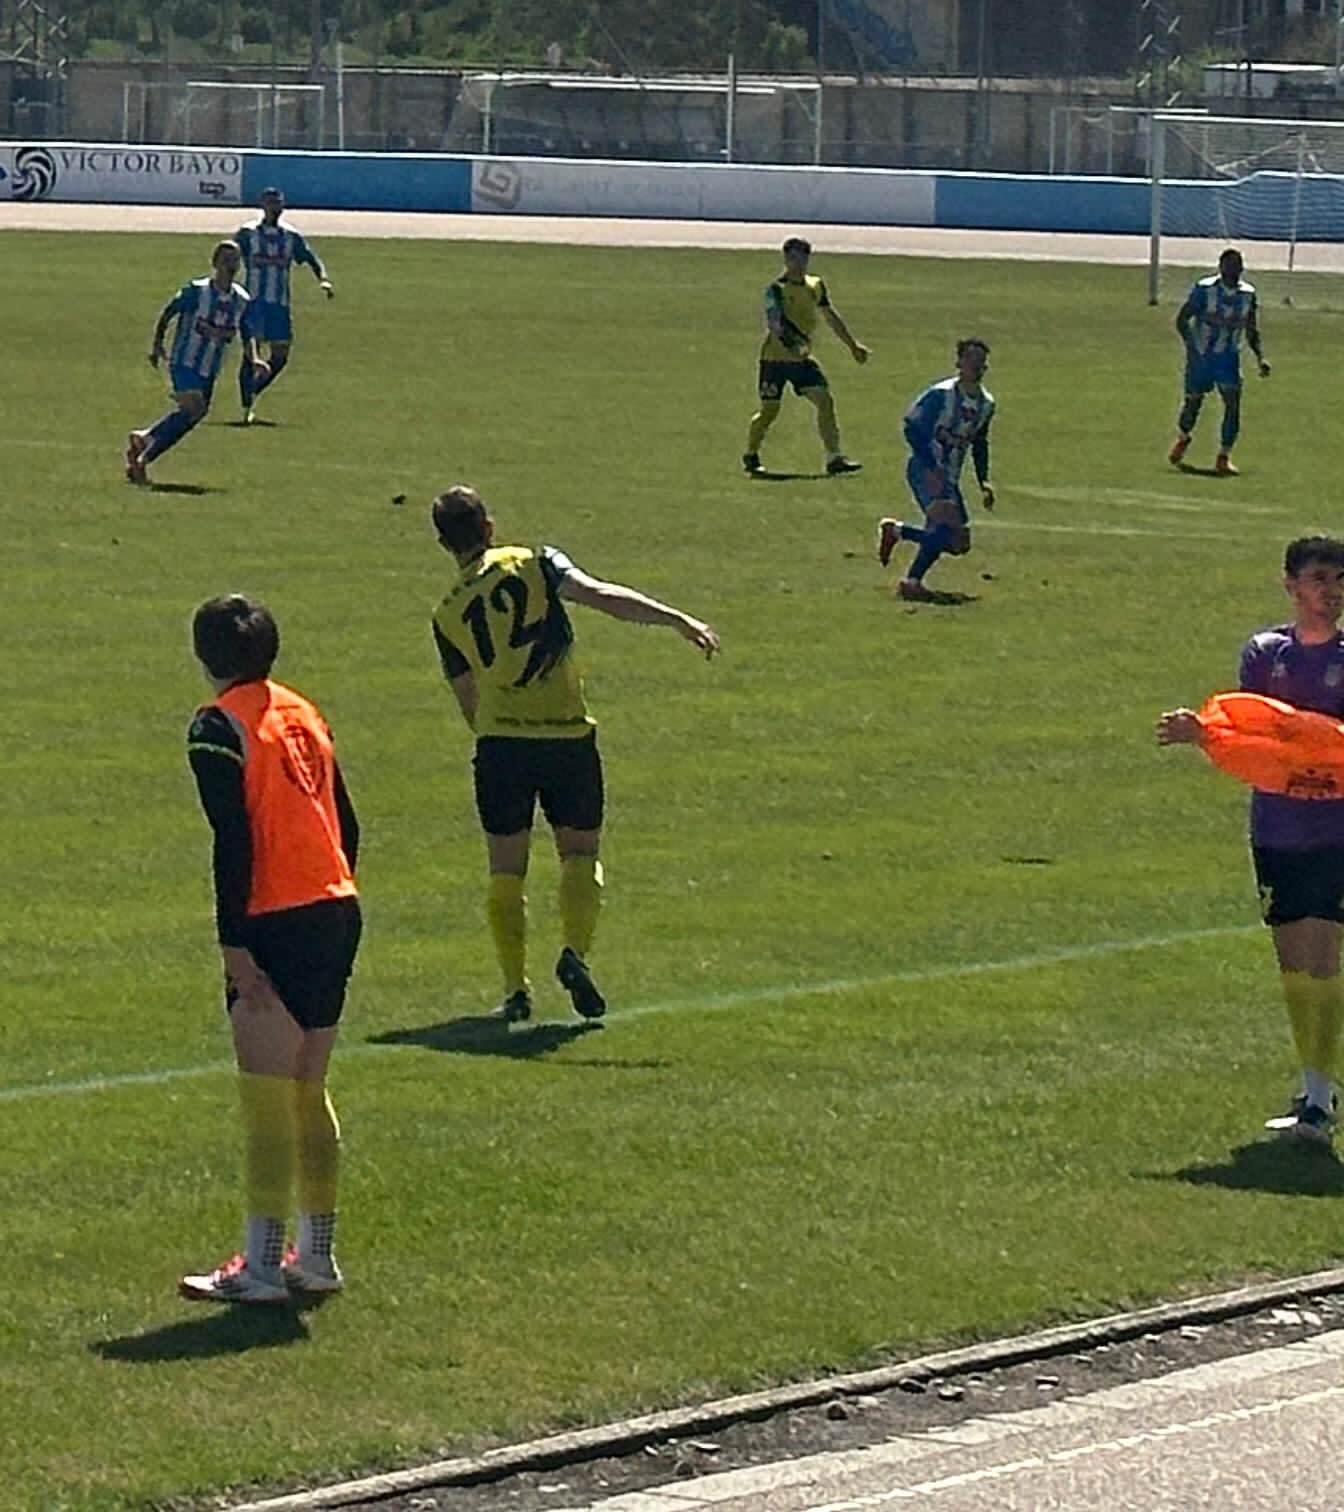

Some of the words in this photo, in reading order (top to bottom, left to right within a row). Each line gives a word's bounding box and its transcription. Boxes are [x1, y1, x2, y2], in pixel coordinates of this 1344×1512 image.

[62, 151, 161, 174] VICTOR
[170, 154, 240, 175] BAYO
[463, 575, 544, 669] 12
